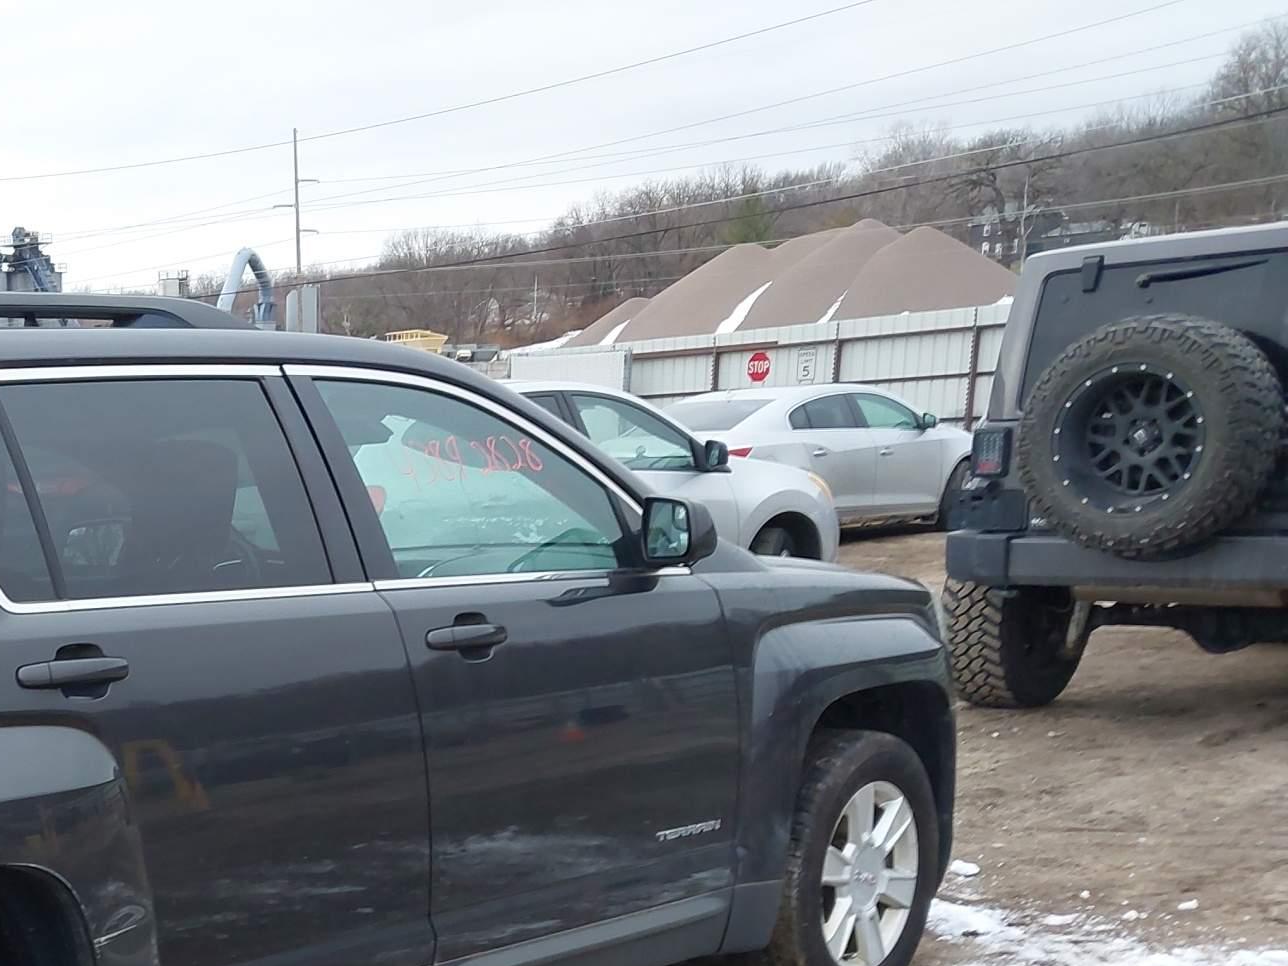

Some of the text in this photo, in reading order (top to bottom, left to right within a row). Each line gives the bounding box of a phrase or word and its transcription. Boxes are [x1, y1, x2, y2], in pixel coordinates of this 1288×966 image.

[748, 360, 770, 374] STOP
[802, 365, 810, 378] 5
[655, 818, 722, 842] TERRAIN
